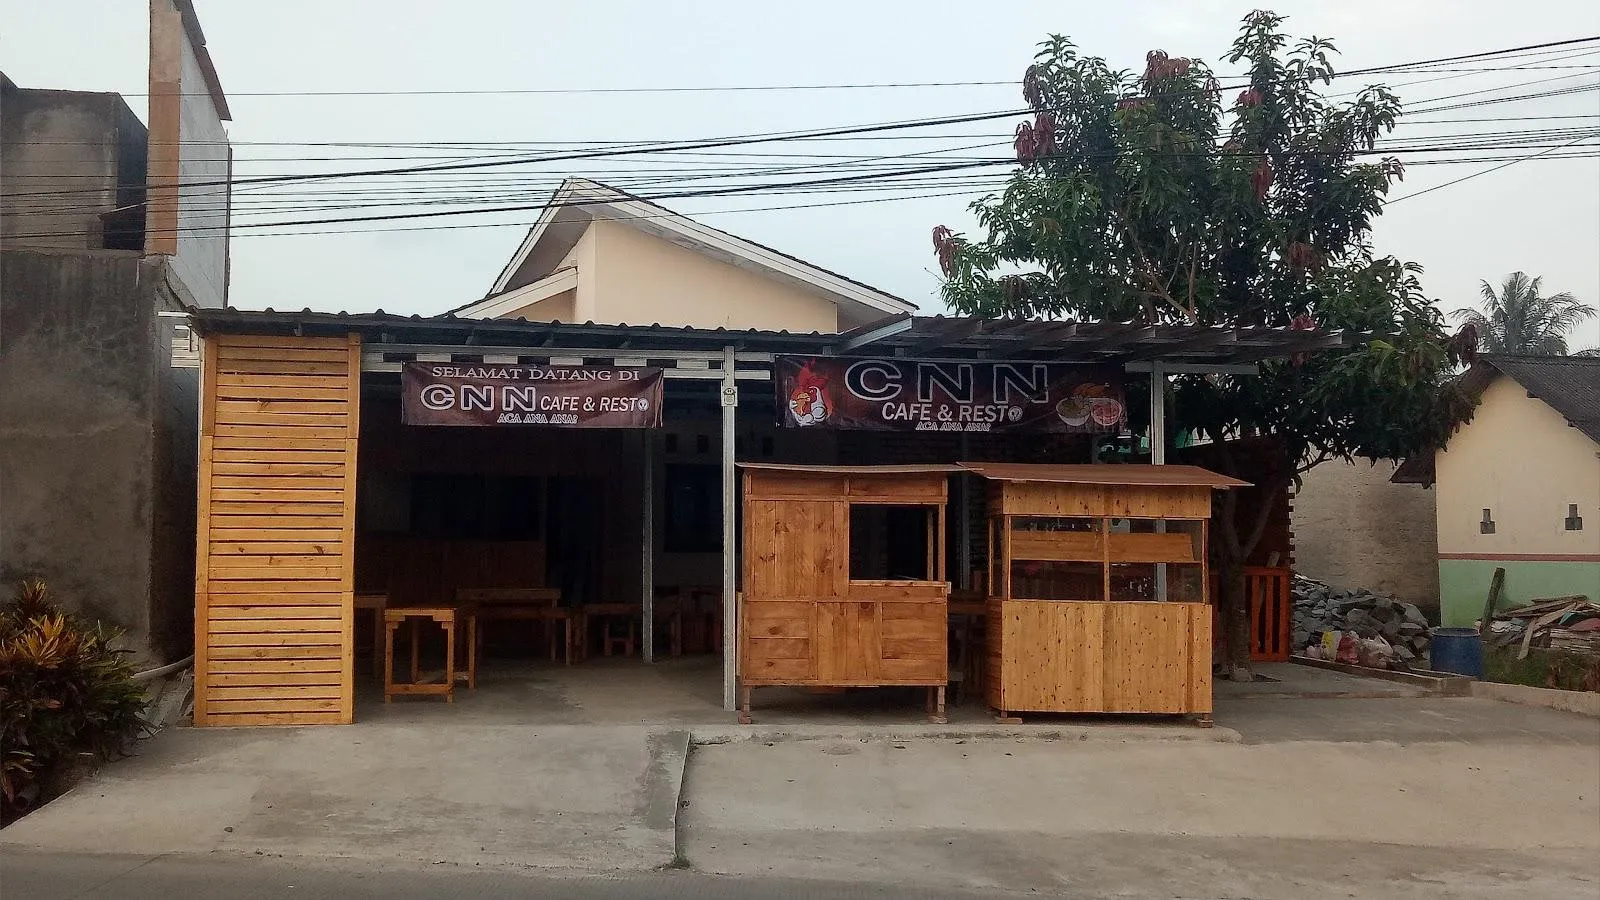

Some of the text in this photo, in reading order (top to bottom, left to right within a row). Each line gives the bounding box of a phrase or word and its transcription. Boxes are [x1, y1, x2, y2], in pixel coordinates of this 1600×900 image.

[432, 366, 640, 381] SELAMAT DATANG DI
[844, 359, 1049, 404] CNN
[420, 383, 537, 411] CNN
[540, 395, 580, 411] CAFE
[583, 396, 596, 412] &
[496, 413, 523, 423] ACA
[881, 402, 931, 421] CAFE
[937, 404, 953, 422] &
